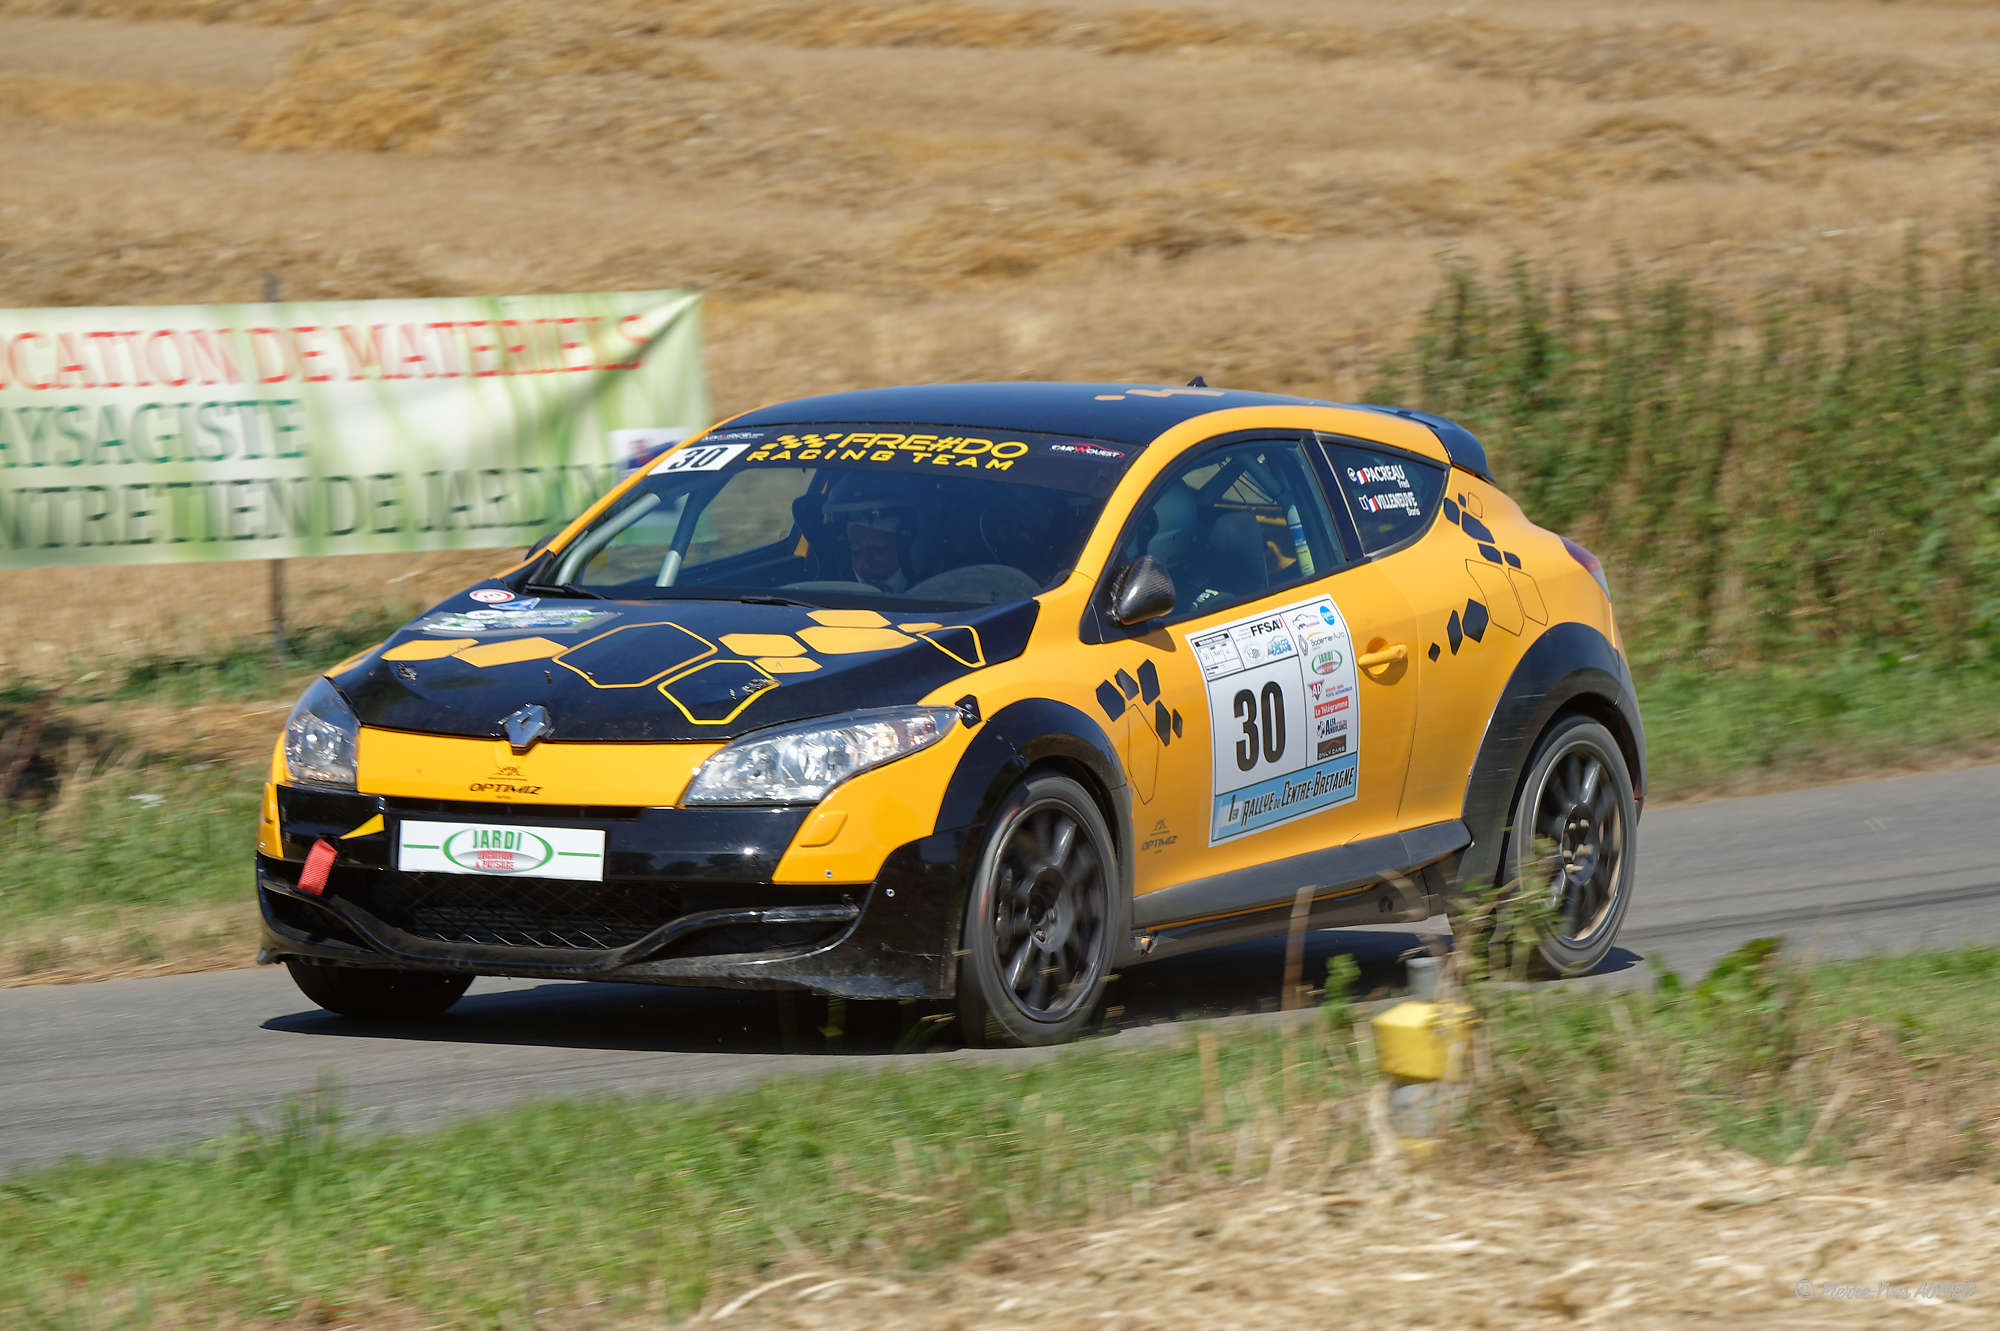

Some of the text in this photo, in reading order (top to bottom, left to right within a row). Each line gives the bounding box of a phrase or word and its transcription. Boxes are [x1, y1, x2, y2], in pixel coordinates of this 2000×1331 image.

[0, 328, 240, 391] CATION
[246, 326, 332, 384] DE
[667, 446, 729, 470] 30
[746, 448, 1015, 471] RACING TEAM
[1363, 464, 1406, 483] PACREAU
[323, 472, 402, 537] DE
[1374, 491, 1417, 510] VILLENEUVE
[1250, 619, 1282, 637] FFSA
[1233, 680, 1287, 772] 30
[469, 782, 544, 796] OPTIMIZ
[1240, 792, 1274, 827] RALLYE
[472, 830, 523, 851] JARDI
